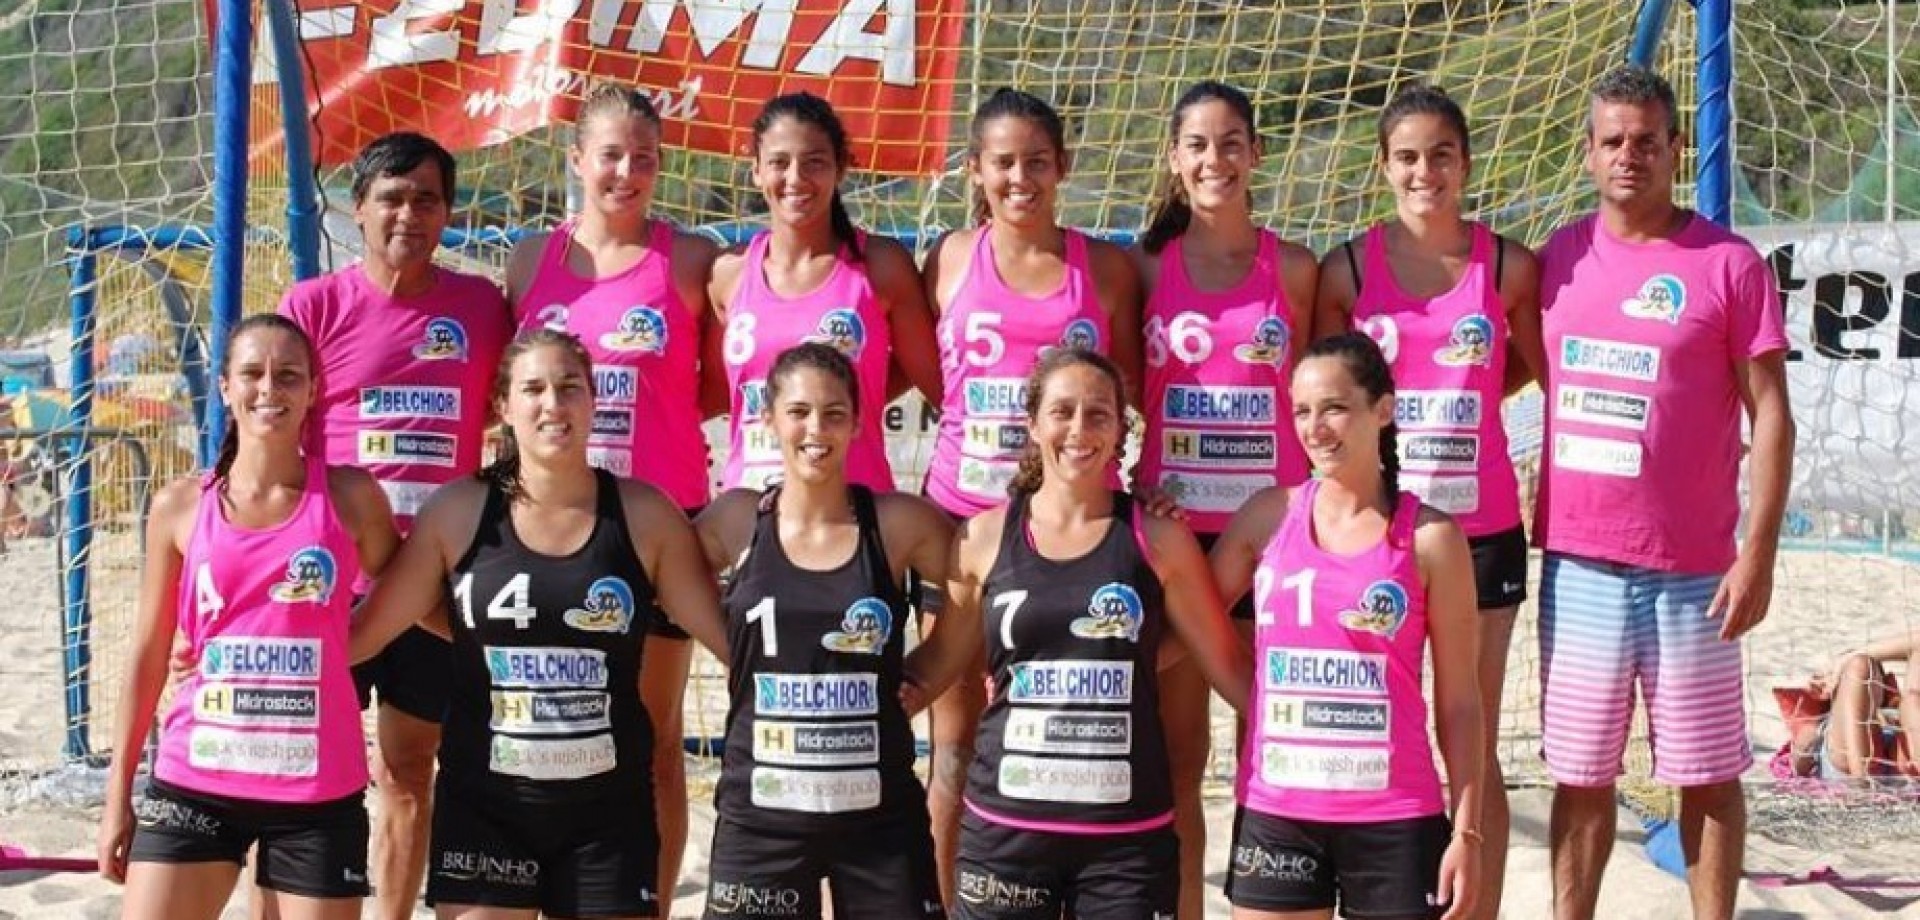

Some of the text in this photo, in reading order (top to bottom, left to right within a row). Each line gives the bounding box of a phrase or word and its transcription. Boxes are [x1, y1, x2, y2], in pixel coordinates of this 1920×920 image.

[383, 391, 456, 413] BELCHIOR
[1187, 394, 1270, 419] BELCHIOR
[366, 436, 386, 451] H
[1171, 435, 1273, 454] H Hidrostock
[1407, 438, 1476, 456] Hidrostock
[454, 573, 537, 629] 14
[745, 596, 778, 658] 1
[992, 590, 1028, 650] 7
[510, 654, 602, 682] BELCHIOR
[1289, 655, 1383, 687] BELCHIOR
[778, 679, 872, 708] BELCHIOR
[1033, 668, 1126, 696] BELCHIOR
[203, 691, 316, 711] H Hidrostock
[1273, 702, 1384, 724] H Hidrostock
[763, 729, 873, 750] H Hidrostock
[1047, 720, 1127, 738] Hidrostock
